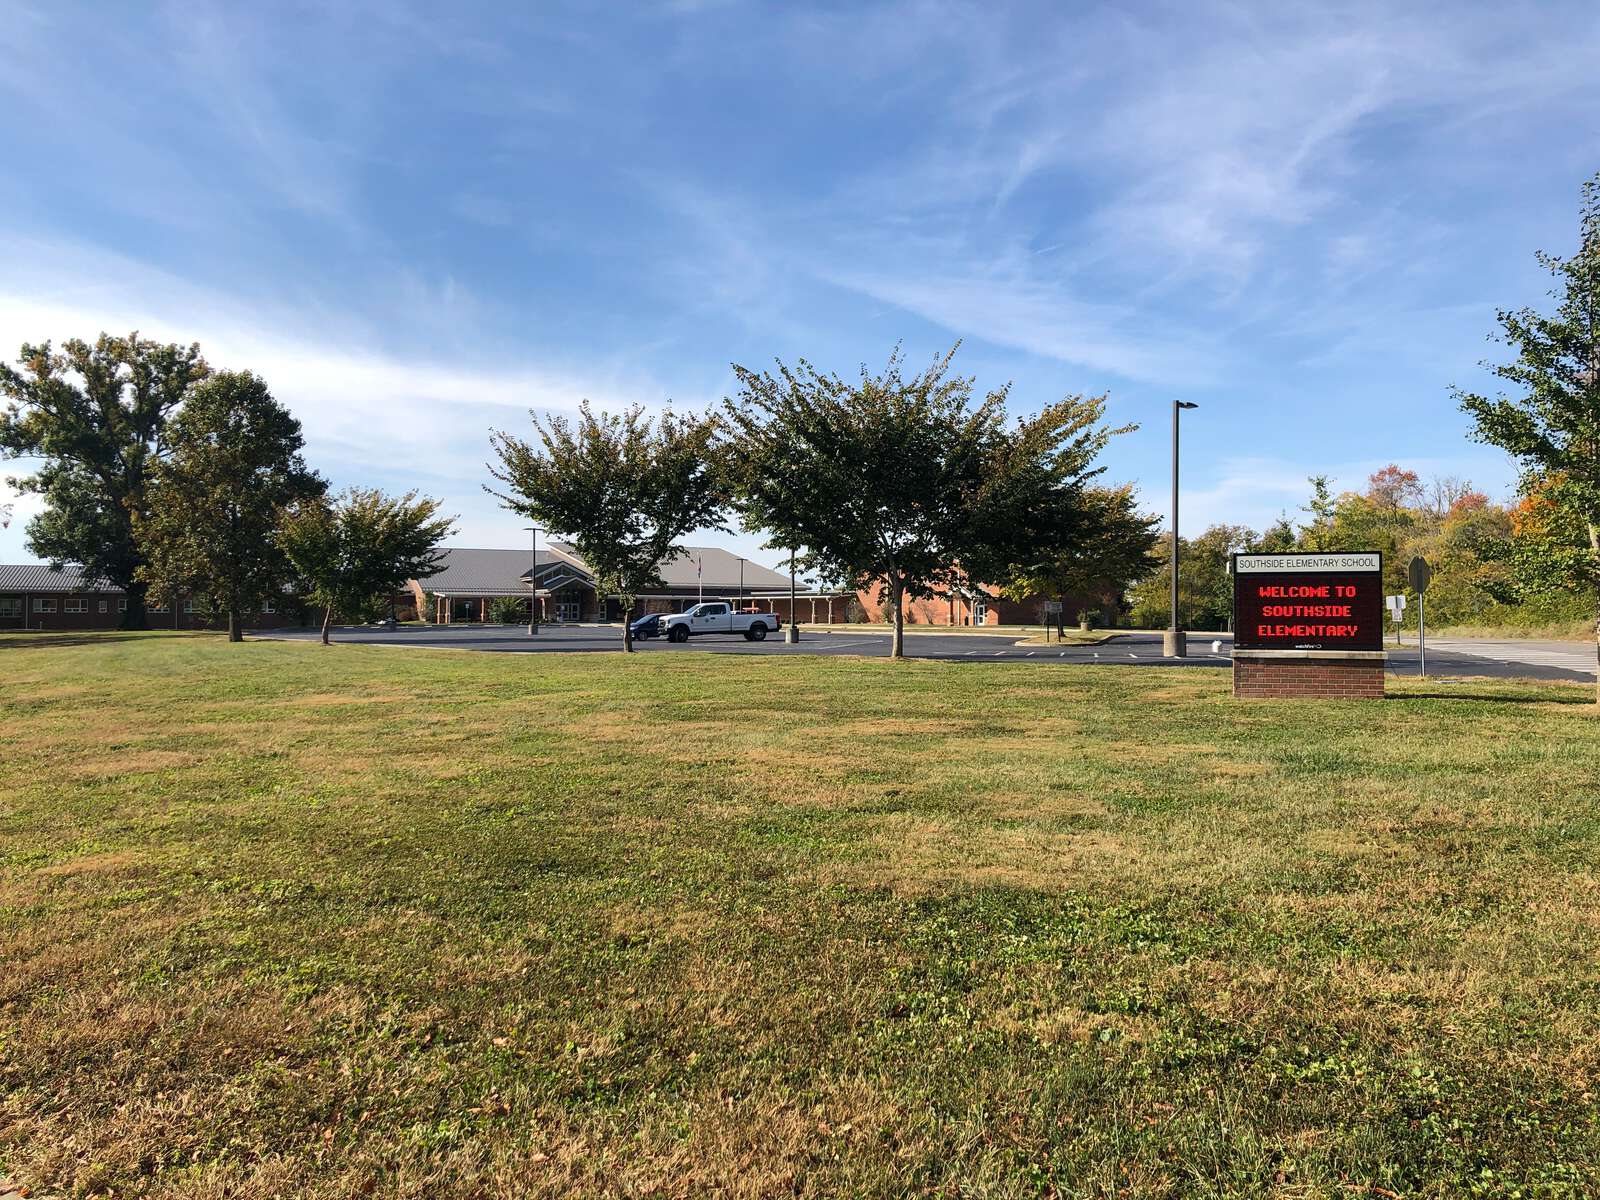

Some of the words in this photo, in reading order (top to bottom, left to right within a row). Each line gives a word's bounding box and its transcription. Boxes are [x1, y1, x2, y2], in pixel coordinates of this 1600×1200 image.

[1239, 559, 1285, 569] SOUTHSIDE
[1286, 558, 1339, 568] ELEMENTARY
[1341, 557, 1376, 568] SCHOOL
[1259, 586, 1330, 598] WELCOME
[1335, 585, 1356, 598] TO
[1262, 605, 1352, 617] SOUTHSIDE
[1258, 625, 1358, 637] ELEMENTARY
